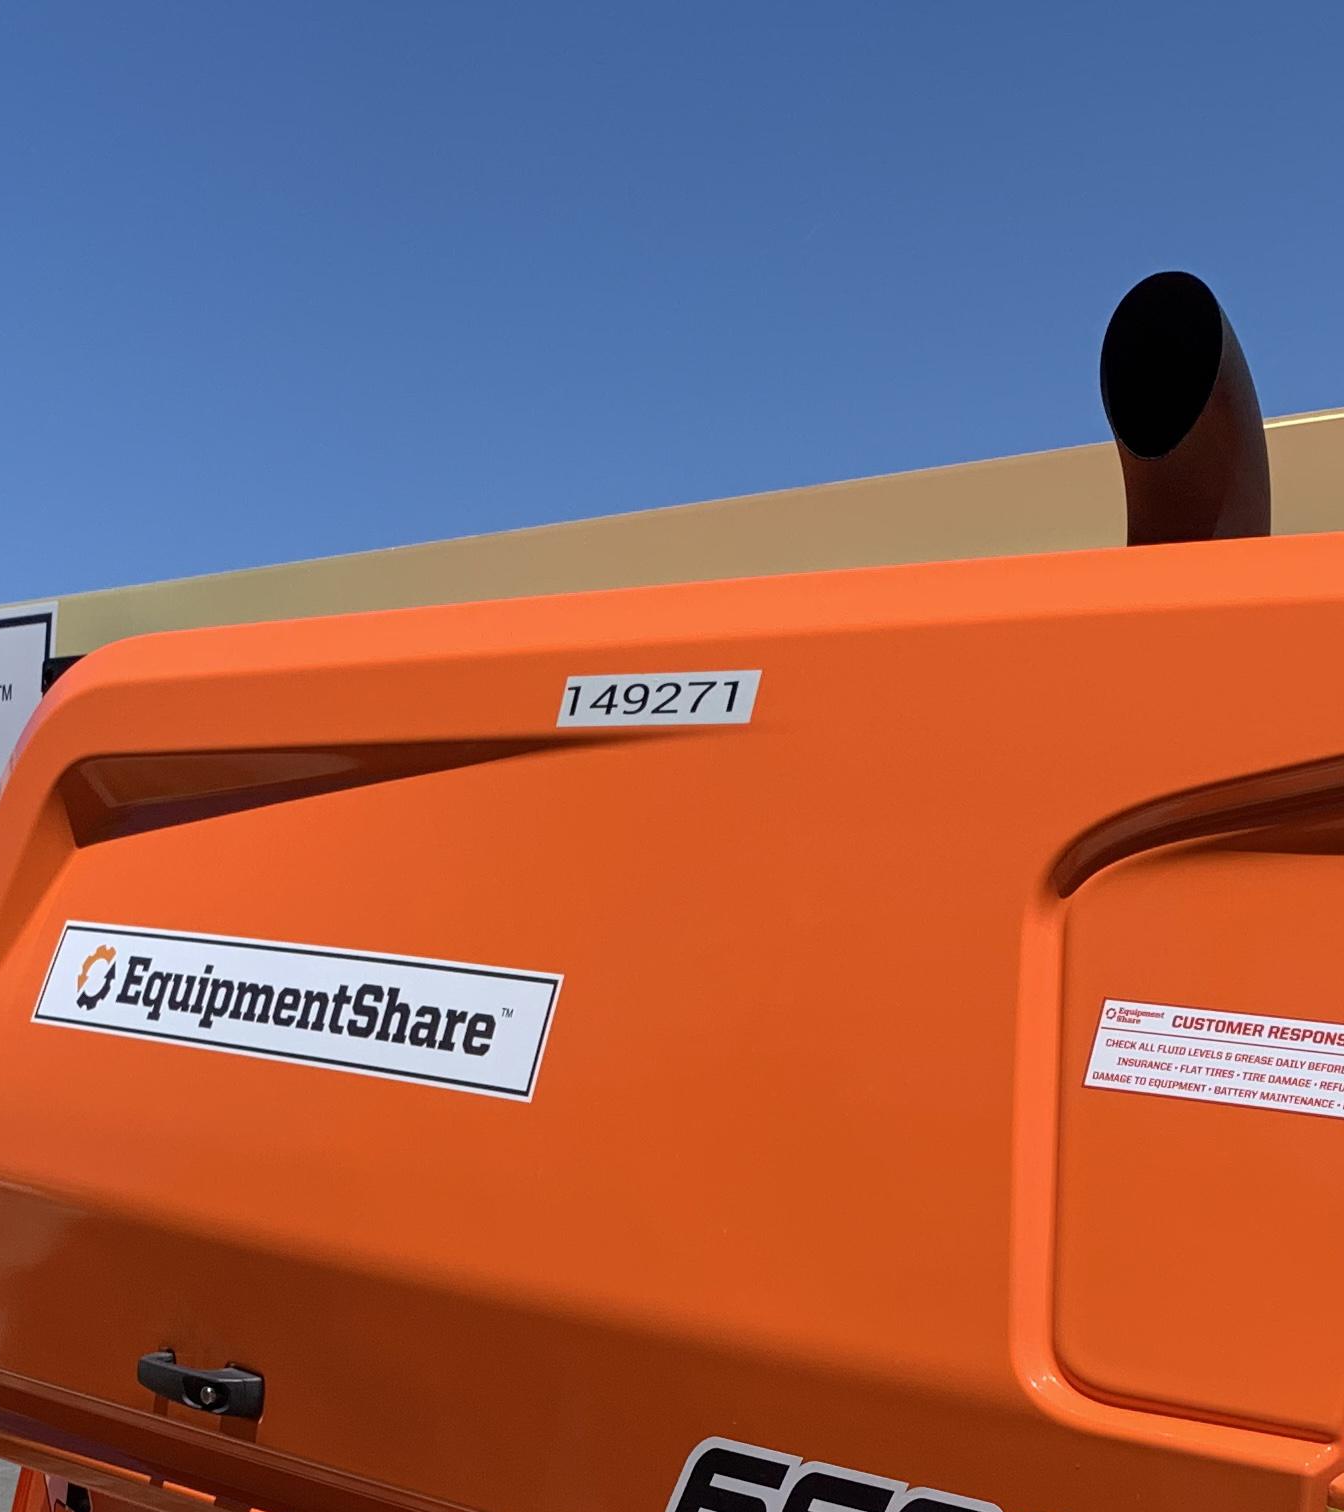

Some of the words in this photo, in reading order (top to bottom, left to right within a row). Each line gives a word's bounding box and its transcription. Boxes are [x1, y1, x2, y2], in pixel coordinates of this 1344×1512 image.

[567, 680, 742, 717] 149271
[116, 955, 497, 1057] EquipmentShare
[1170, 1014, 1265, 1038] CUSTOMER
[1104, 1038, 1136, 1050] CHECK
[1137, 1041, 1156, 1052] ALL
[1156, 1043, 1187, 1056] FLUID
[1186, 1047, 1223, 1060] LEVELS
[1223, 1051, 1232, 1061] &
[1233, 1052, 1274, 1066] GREASE
[1274, 1057, 1306, 1070] DAILY
[1115, 1056, 1173, 1072] INSURANCE
[1178, 1064, 1203, 1076] FLAT
[1203, 1067, 1234, 1079] TIRES
[1240, 1071, 1266, 1083] TIRE
[1266, 1074, 1312, 1088] DAMAGE
[1090, 1071, 1132, 1085] DAMAGE
[1132, 1076, 1147, 1086] TO
[1147, 1077, 1206, 1093] EQUIPMENT
[1212, 1085, 1258, 1100] BATTERY
[1257, 1090, 1335, 1109] MAINTENANCE
